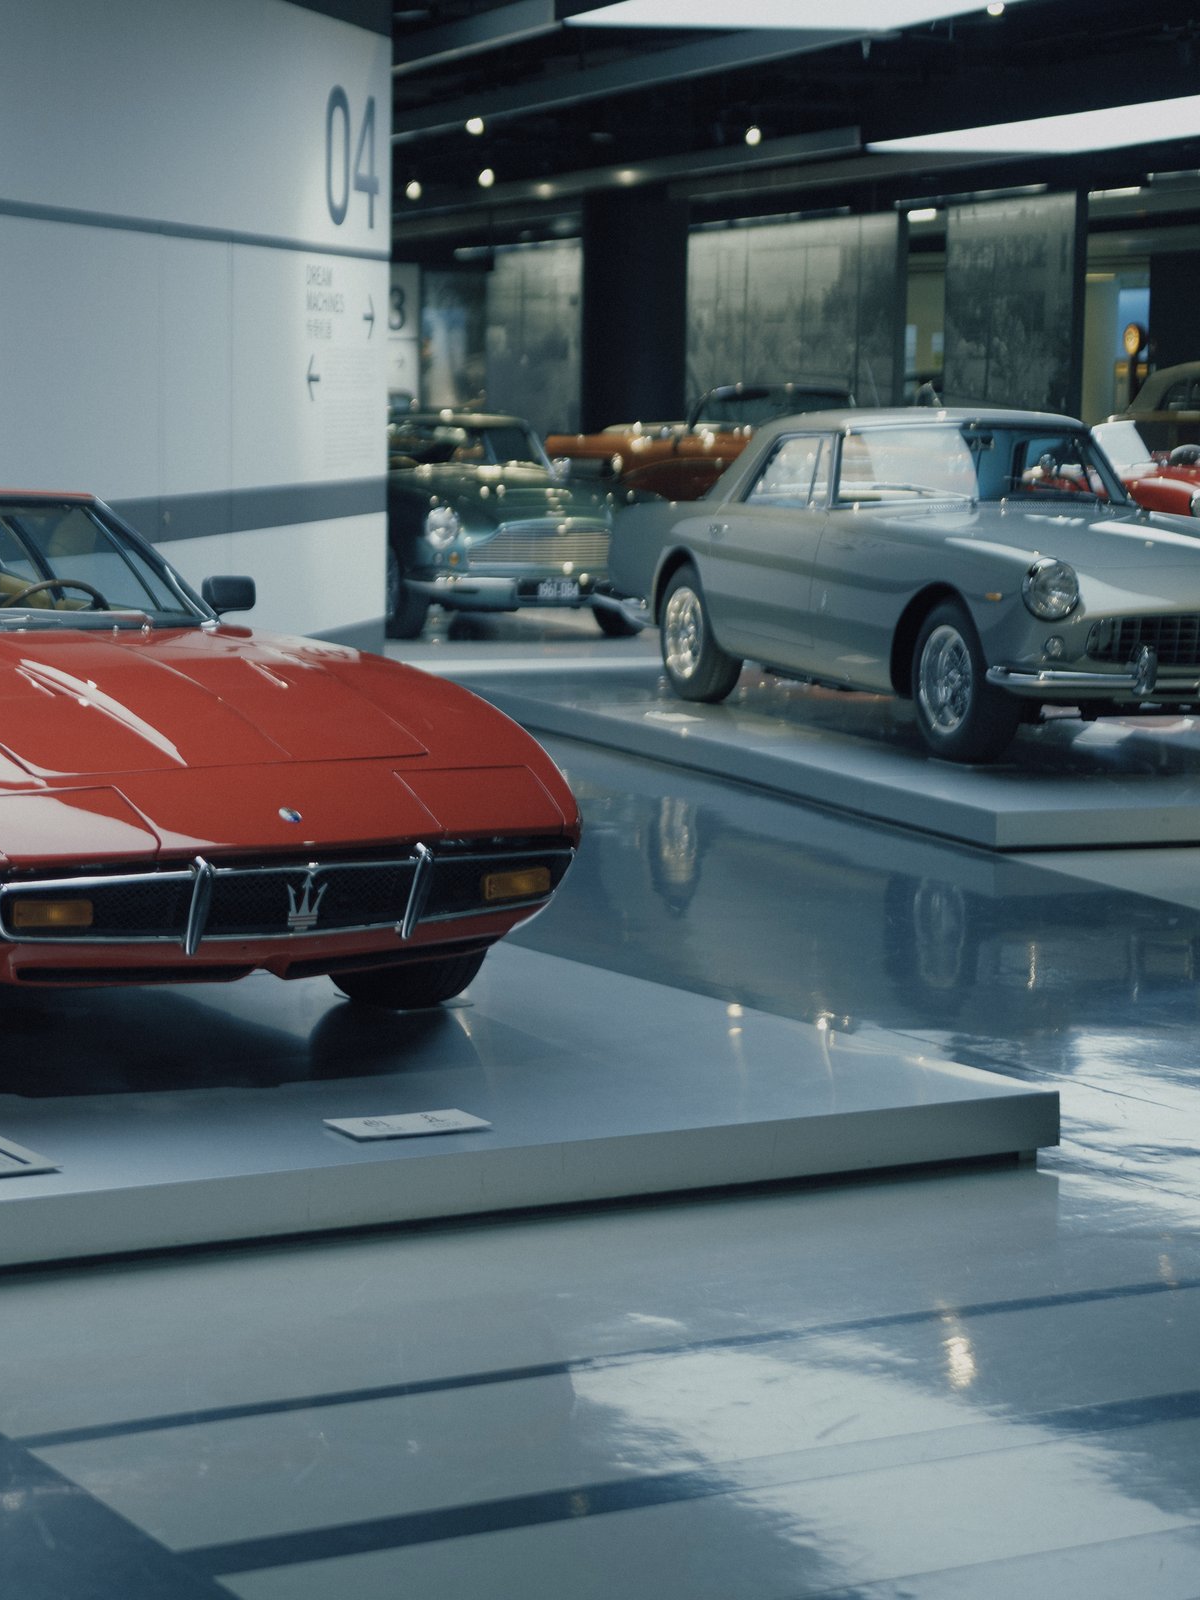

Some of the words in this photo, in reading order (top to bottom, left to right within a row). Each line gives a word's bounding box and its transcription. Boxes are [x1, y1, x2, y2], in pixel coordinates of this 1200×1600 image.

[326, 84, 379, 229] 04
[306, 264, 333, 287] DREAM
[306, 287, 345, 313] MACHINES
